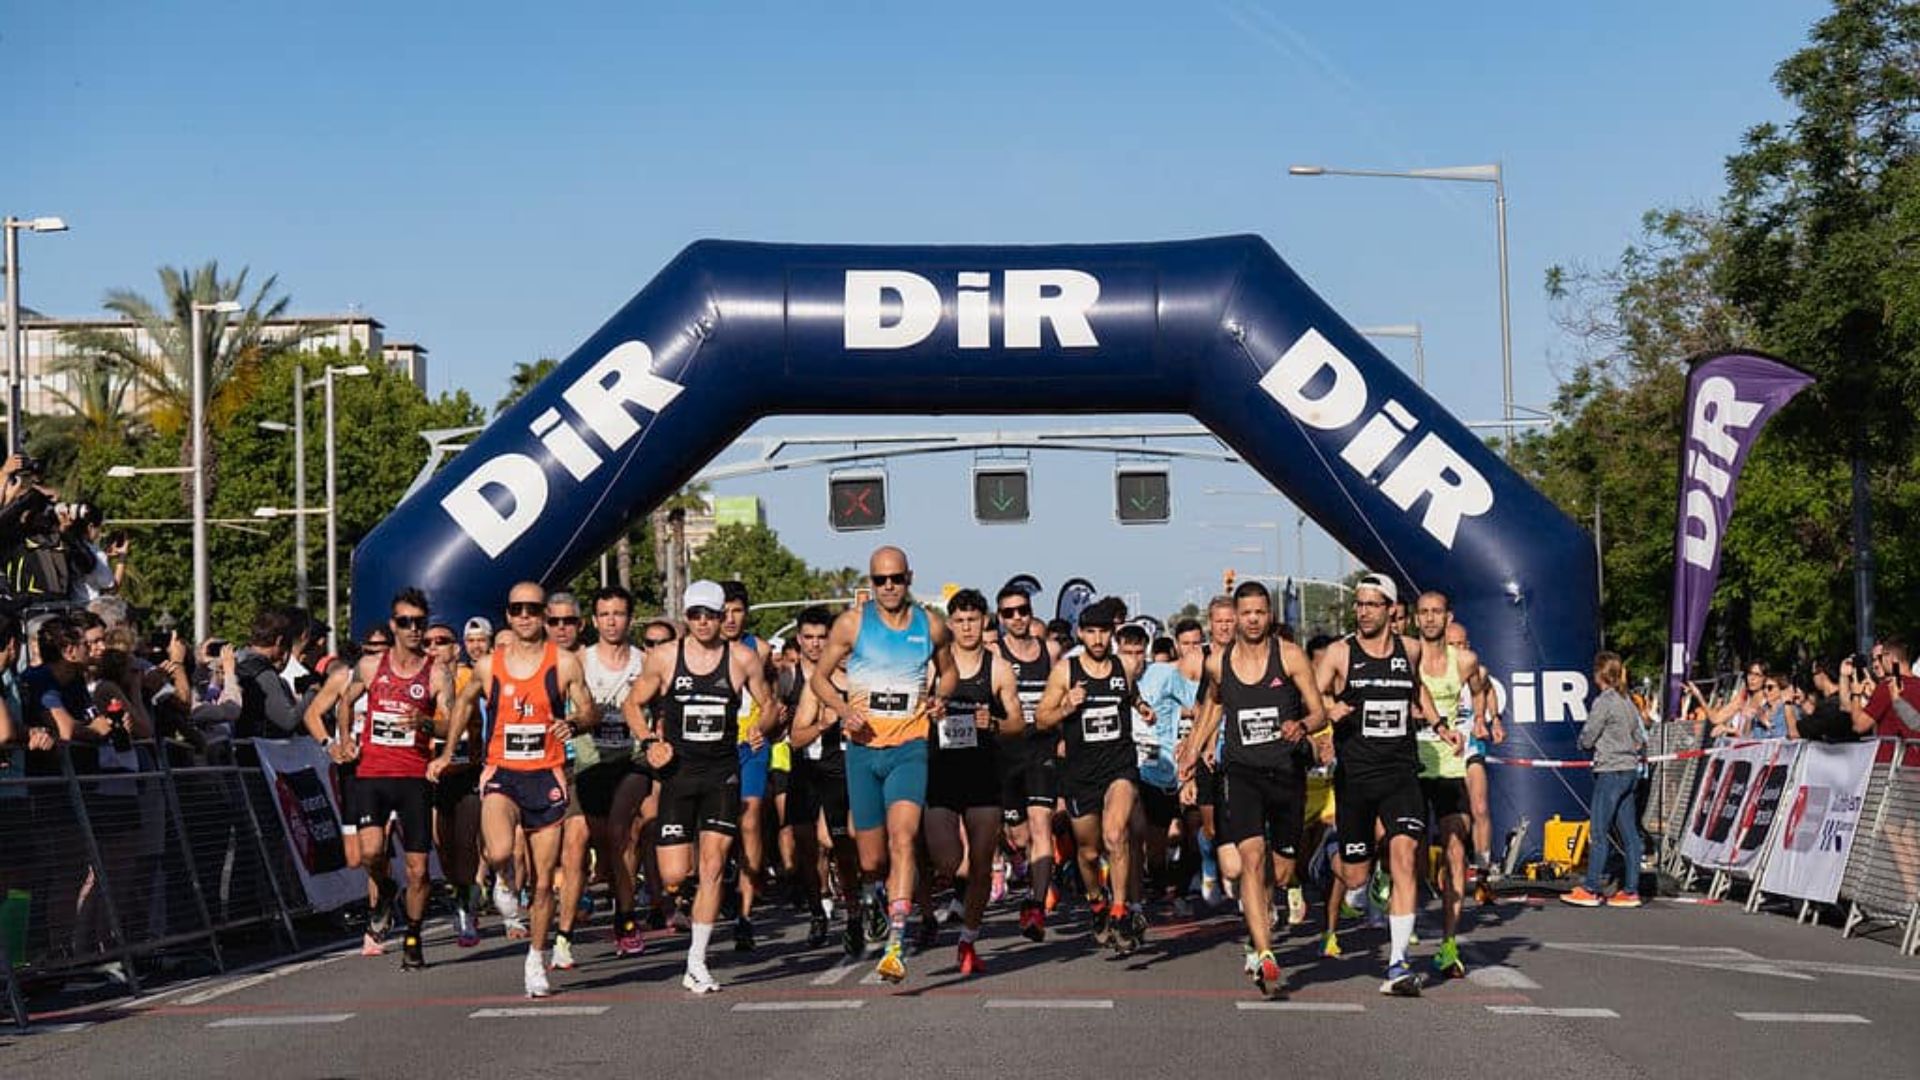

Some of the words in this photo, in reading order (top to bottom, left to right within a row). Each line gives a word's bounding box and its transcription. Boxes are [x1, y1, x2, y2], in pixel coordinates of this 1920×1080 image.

[845, 269, 1100, 348] DiR
[440, 340, 685, 560] DiR
[1258, 327, 1494, 550] DiR
[1685, 376, 1764, 571] DiR
